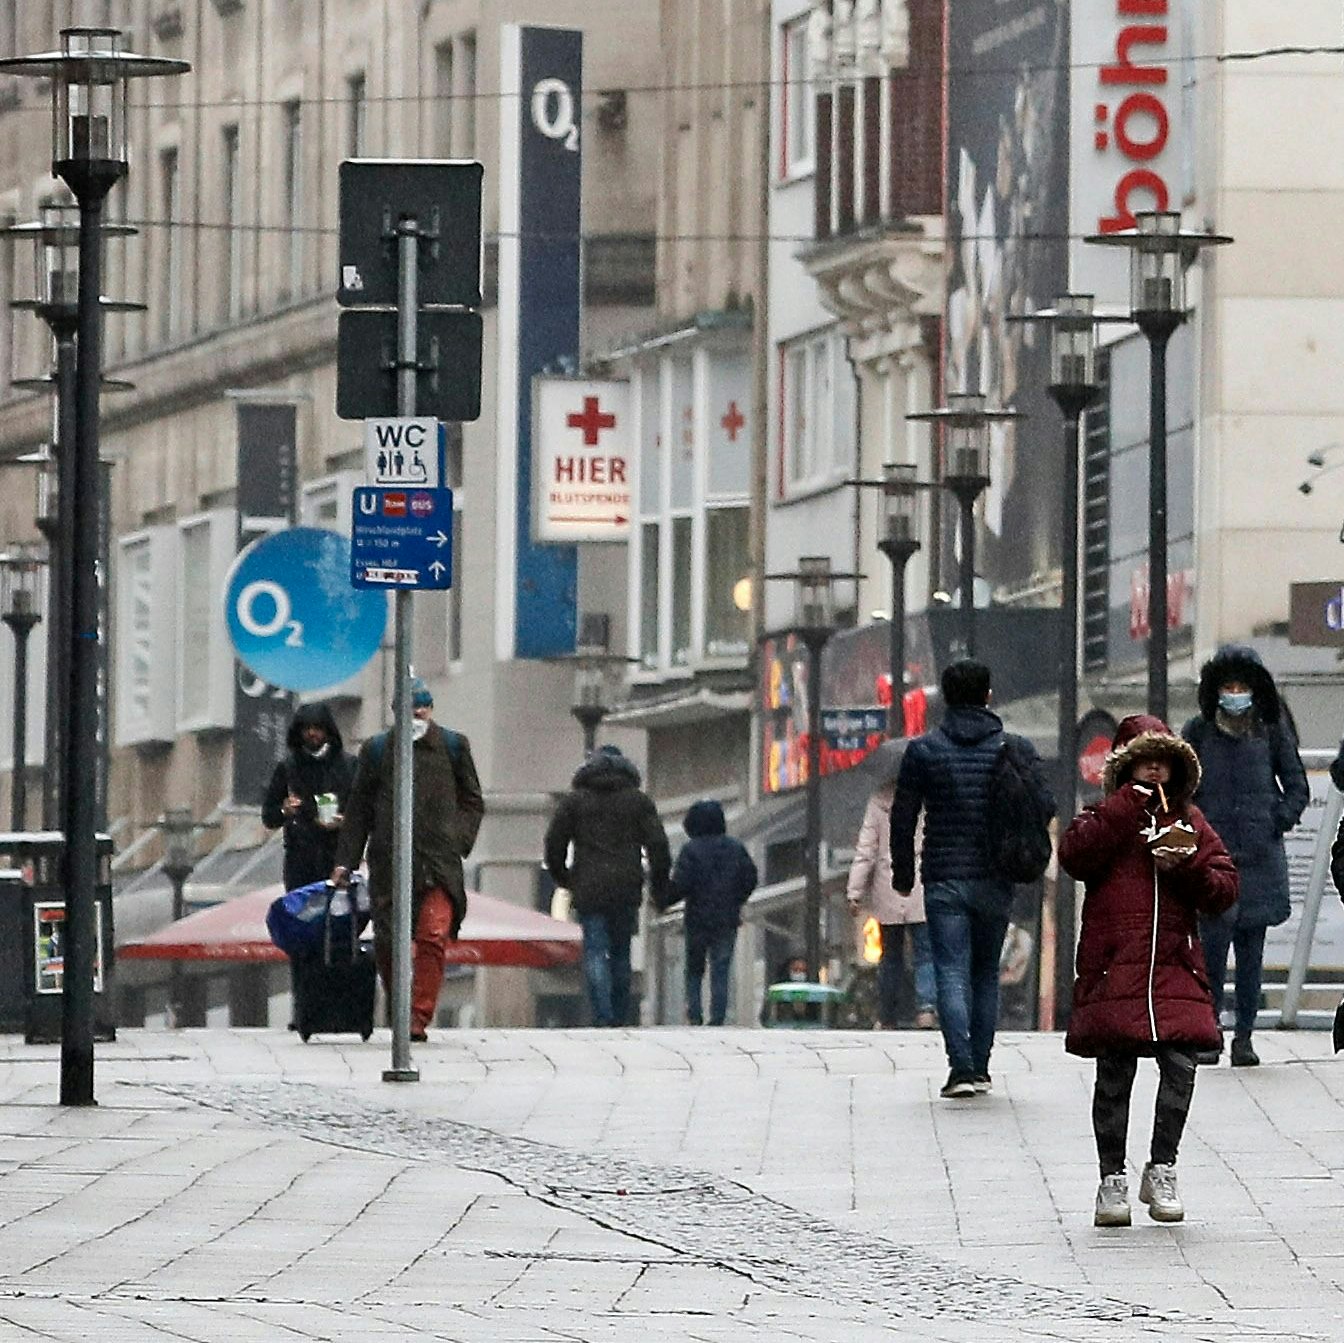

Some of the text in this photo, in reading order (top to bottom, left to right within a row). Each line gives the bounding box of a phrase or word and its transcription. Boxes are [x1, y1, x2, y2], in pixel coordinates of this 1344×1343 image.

[1096, 0, 1168, 233] böh
[376, 425, 427, 447] WC
[554, 456, 627, 484] HIER
[360, 494, 377, 515] U
[236, 580, 304, 647] O2
